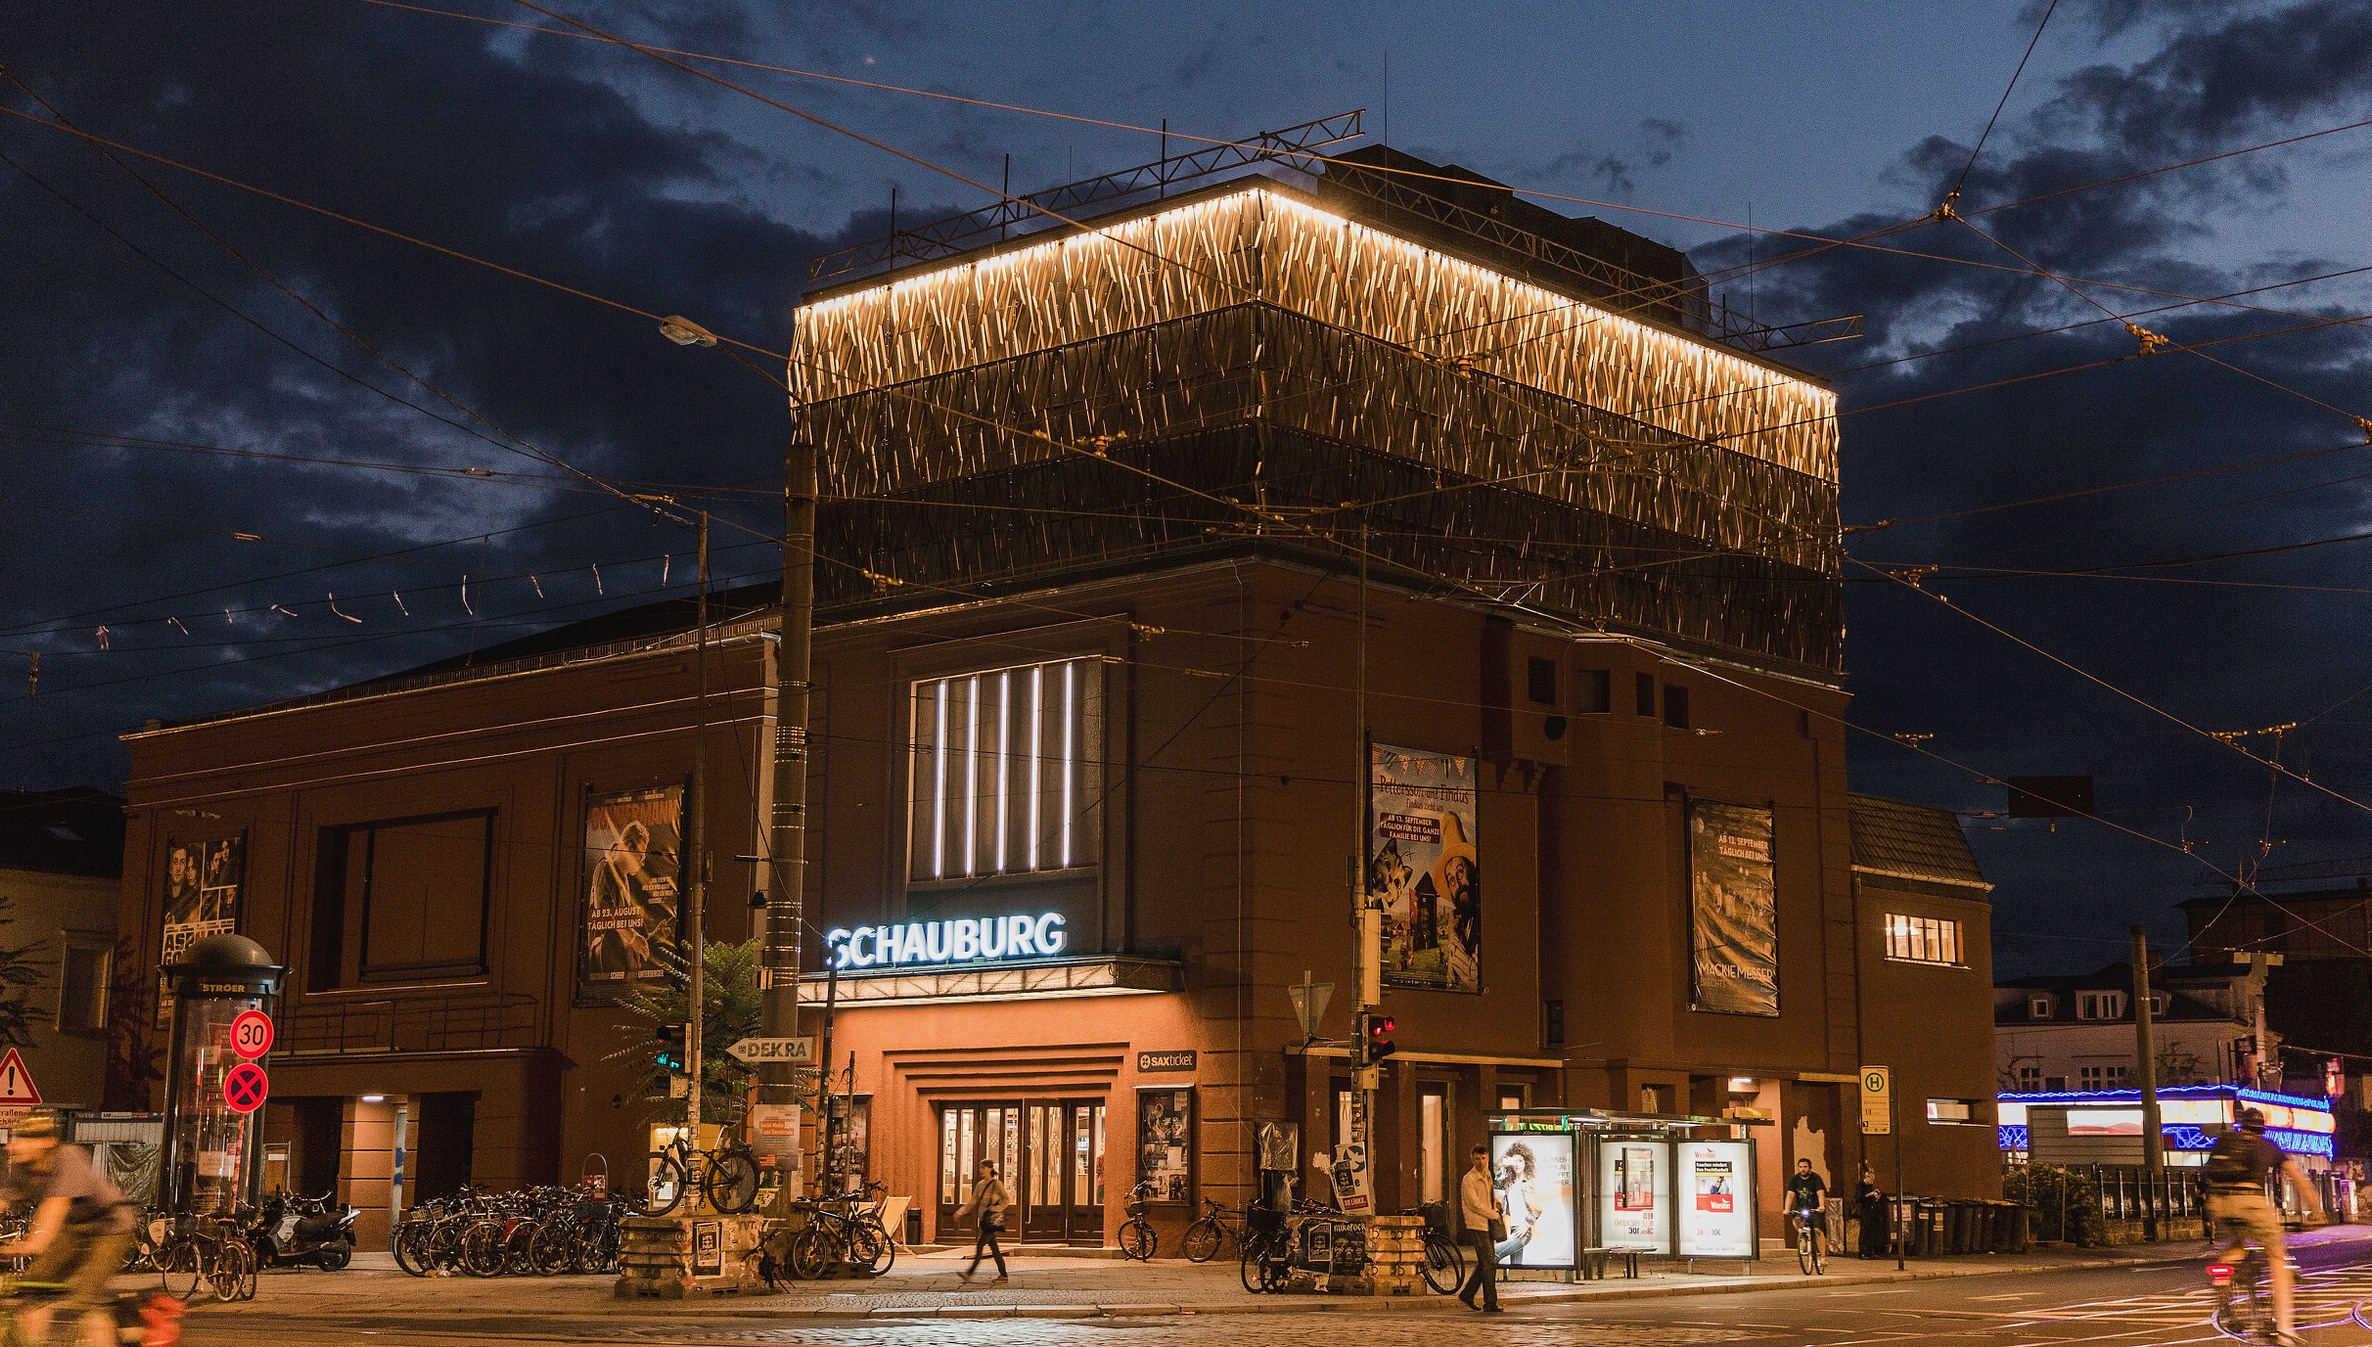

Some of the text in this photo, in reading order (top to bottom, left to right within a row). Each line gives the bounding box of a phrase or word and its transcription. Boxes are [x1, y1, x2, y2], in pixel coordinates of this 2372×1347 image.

[1380, 775, 1424, 798] Pettersson
[1440, 784, 1469, 804] Findus
[1405, 817, 1433, 826] SEPTEMBER
[1389, 831, 1409, 840] FAMILIE
[1719, 834, 1727, 843] AB
[1737, 837, 1769, 849] SEPTEMBER
[1745, 850, 1754, 859] BEI
[591, 906, 640, 918] AB 23. AUGUST
[616, 920, 627, 928] BEI
[628, 918, 643, 927] UNS!
[826, 912, 1067, 969] SCHAUBURG
[1699, 962, 1773, 981] MACKIE MESSER
[202, 984, 245, 992] STRÖER
[239, 1024, 264, 1046] 30
[747, 1042, 807, 1058] DEKRA
[1150, 1053, 1193, 1067] SAXticket
[1870, 1077, 1879, 1088] H
